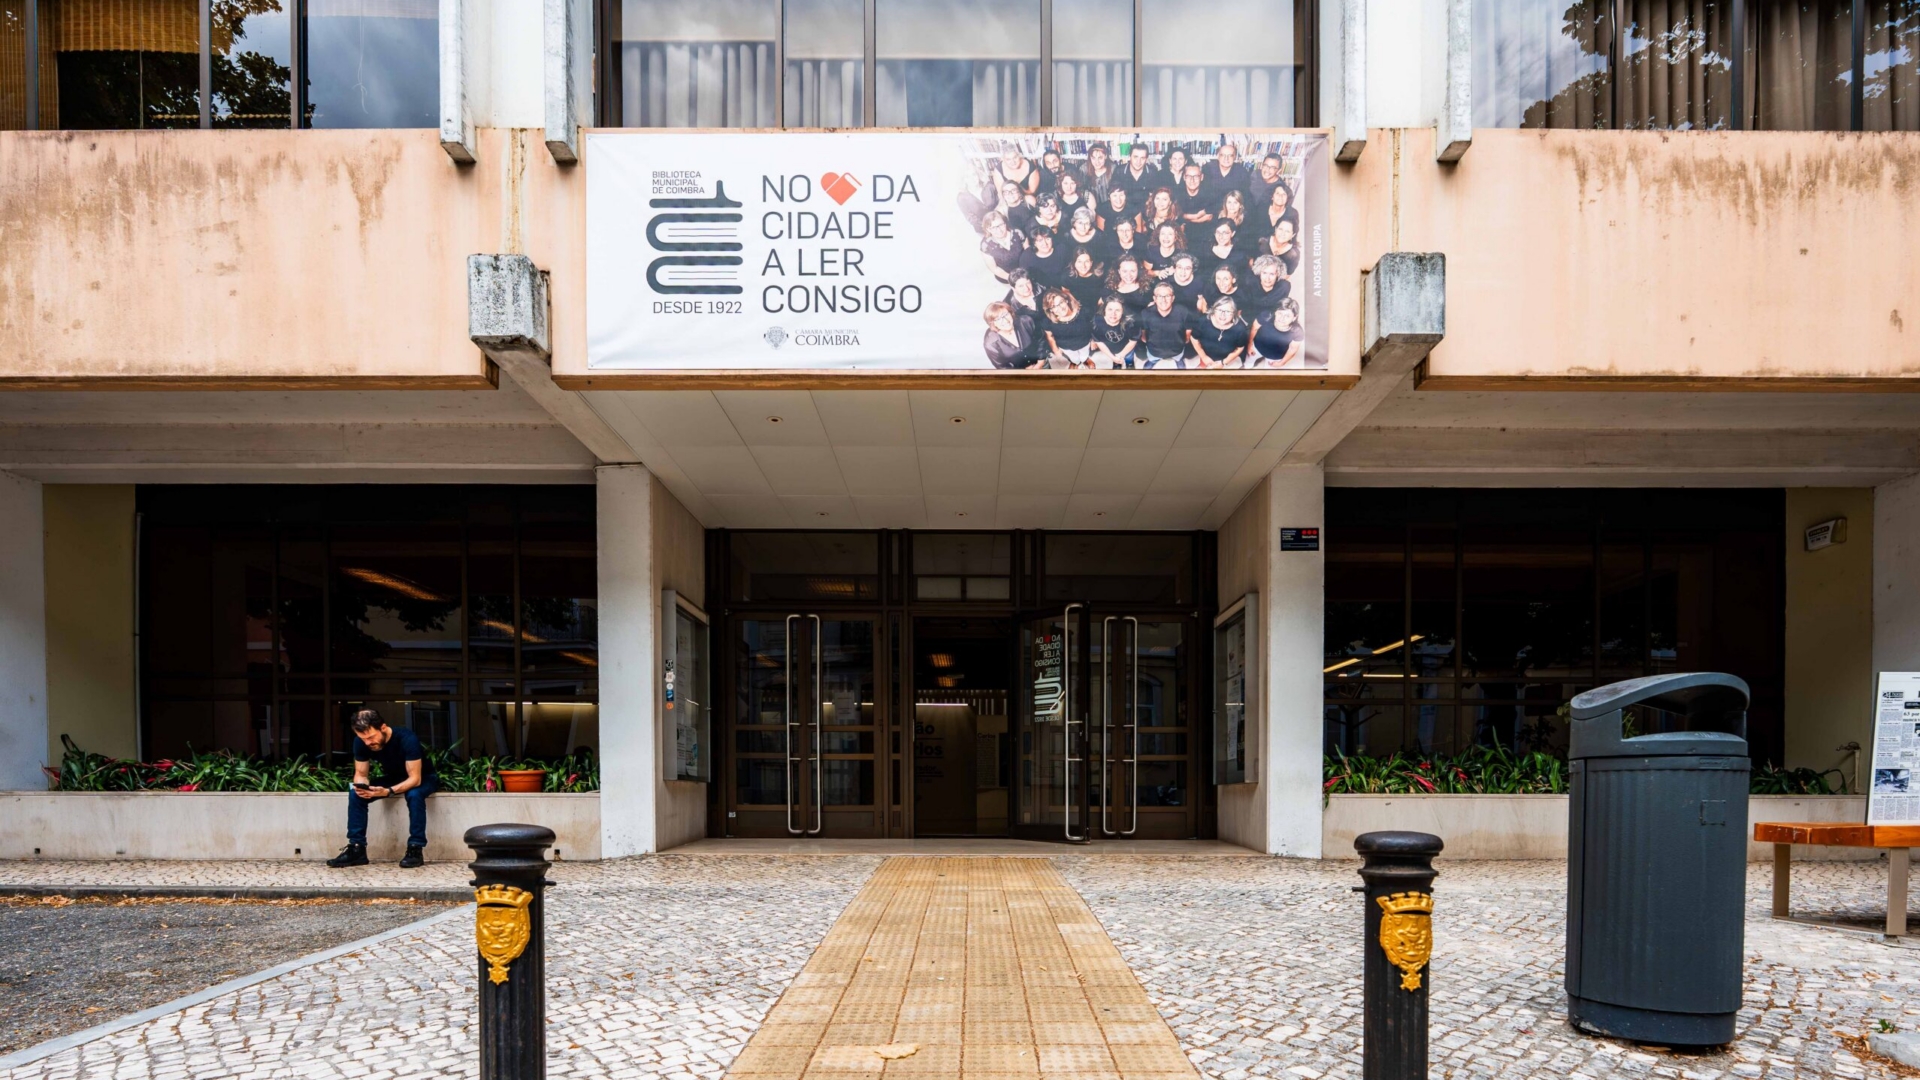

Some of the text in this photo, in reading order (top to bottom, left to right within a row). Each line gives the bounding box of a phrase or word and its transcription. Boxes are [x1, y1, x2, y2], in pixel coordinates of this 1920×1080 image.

[652, 170, 702, 179] BIBLIOTECA
[652, 178, 699, 187] MUNICIPAL
[762, 173, 920, 203] NO DA
[652, 186, 705, 194] DE COIMBRA
[762, 211, 894, 240] CIDADE
[1313, 223, 1322, 257] EQUIPA
[761, 248, 865, 276] A LER
[1313, 257, 1322, 289] NOSSA
[653, 301, 743, 315] DESDE 1922
[762, 284, 923, 314] CONSIGO
[795, 334, 861, 346] COIMBRA
